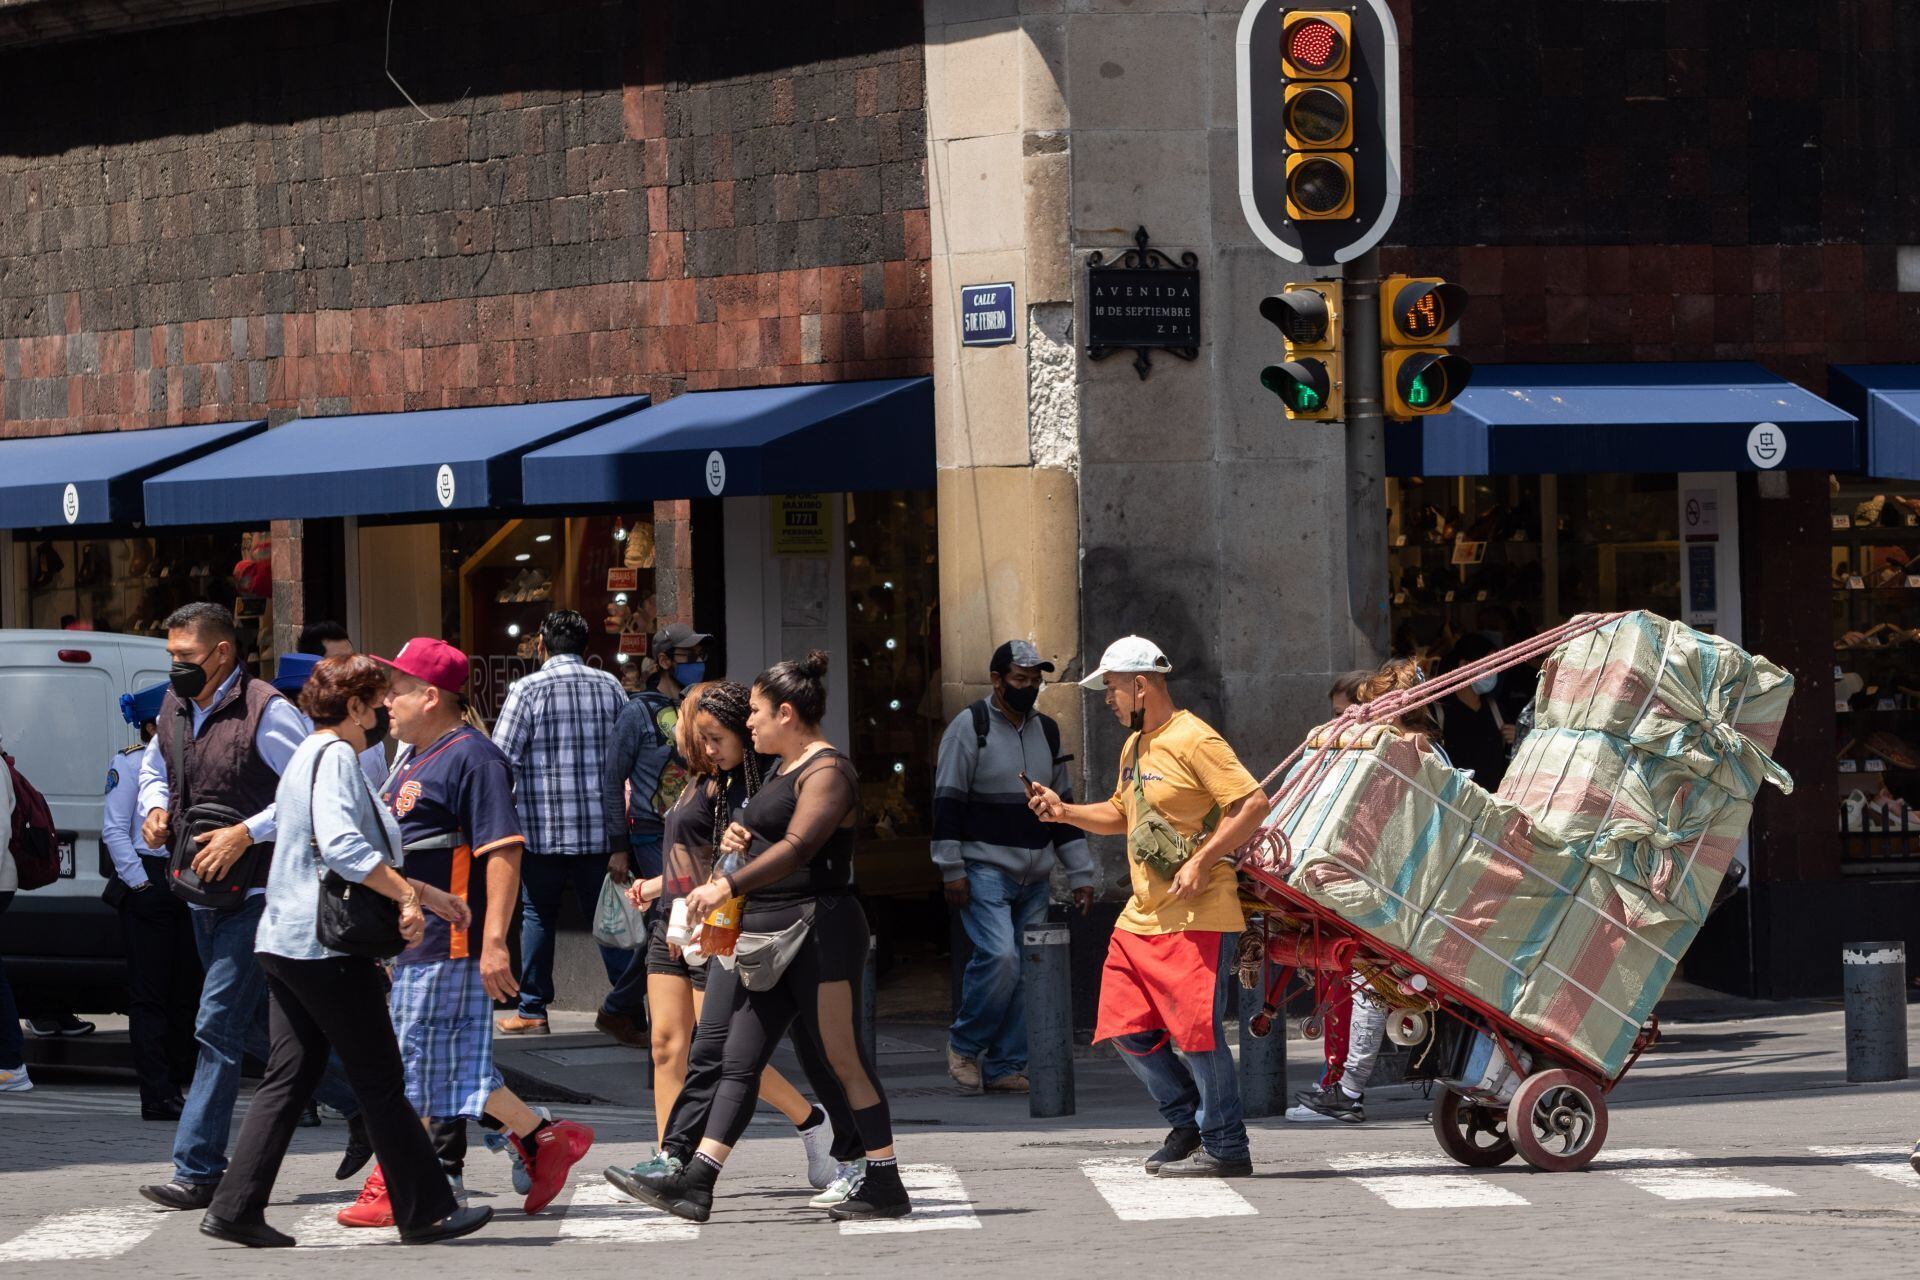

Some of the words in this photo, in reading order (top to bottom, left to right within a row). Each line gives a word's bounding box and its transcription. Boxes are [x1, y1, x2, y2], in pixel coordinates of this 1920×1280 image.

[1095, 286, 1190, 297] AVENIDA
[973, 293, 997, 306] CALLE
[1108, 306, 1123, 316] DE
[1125, 306, 1191, 317] SEPTIEMBRE
